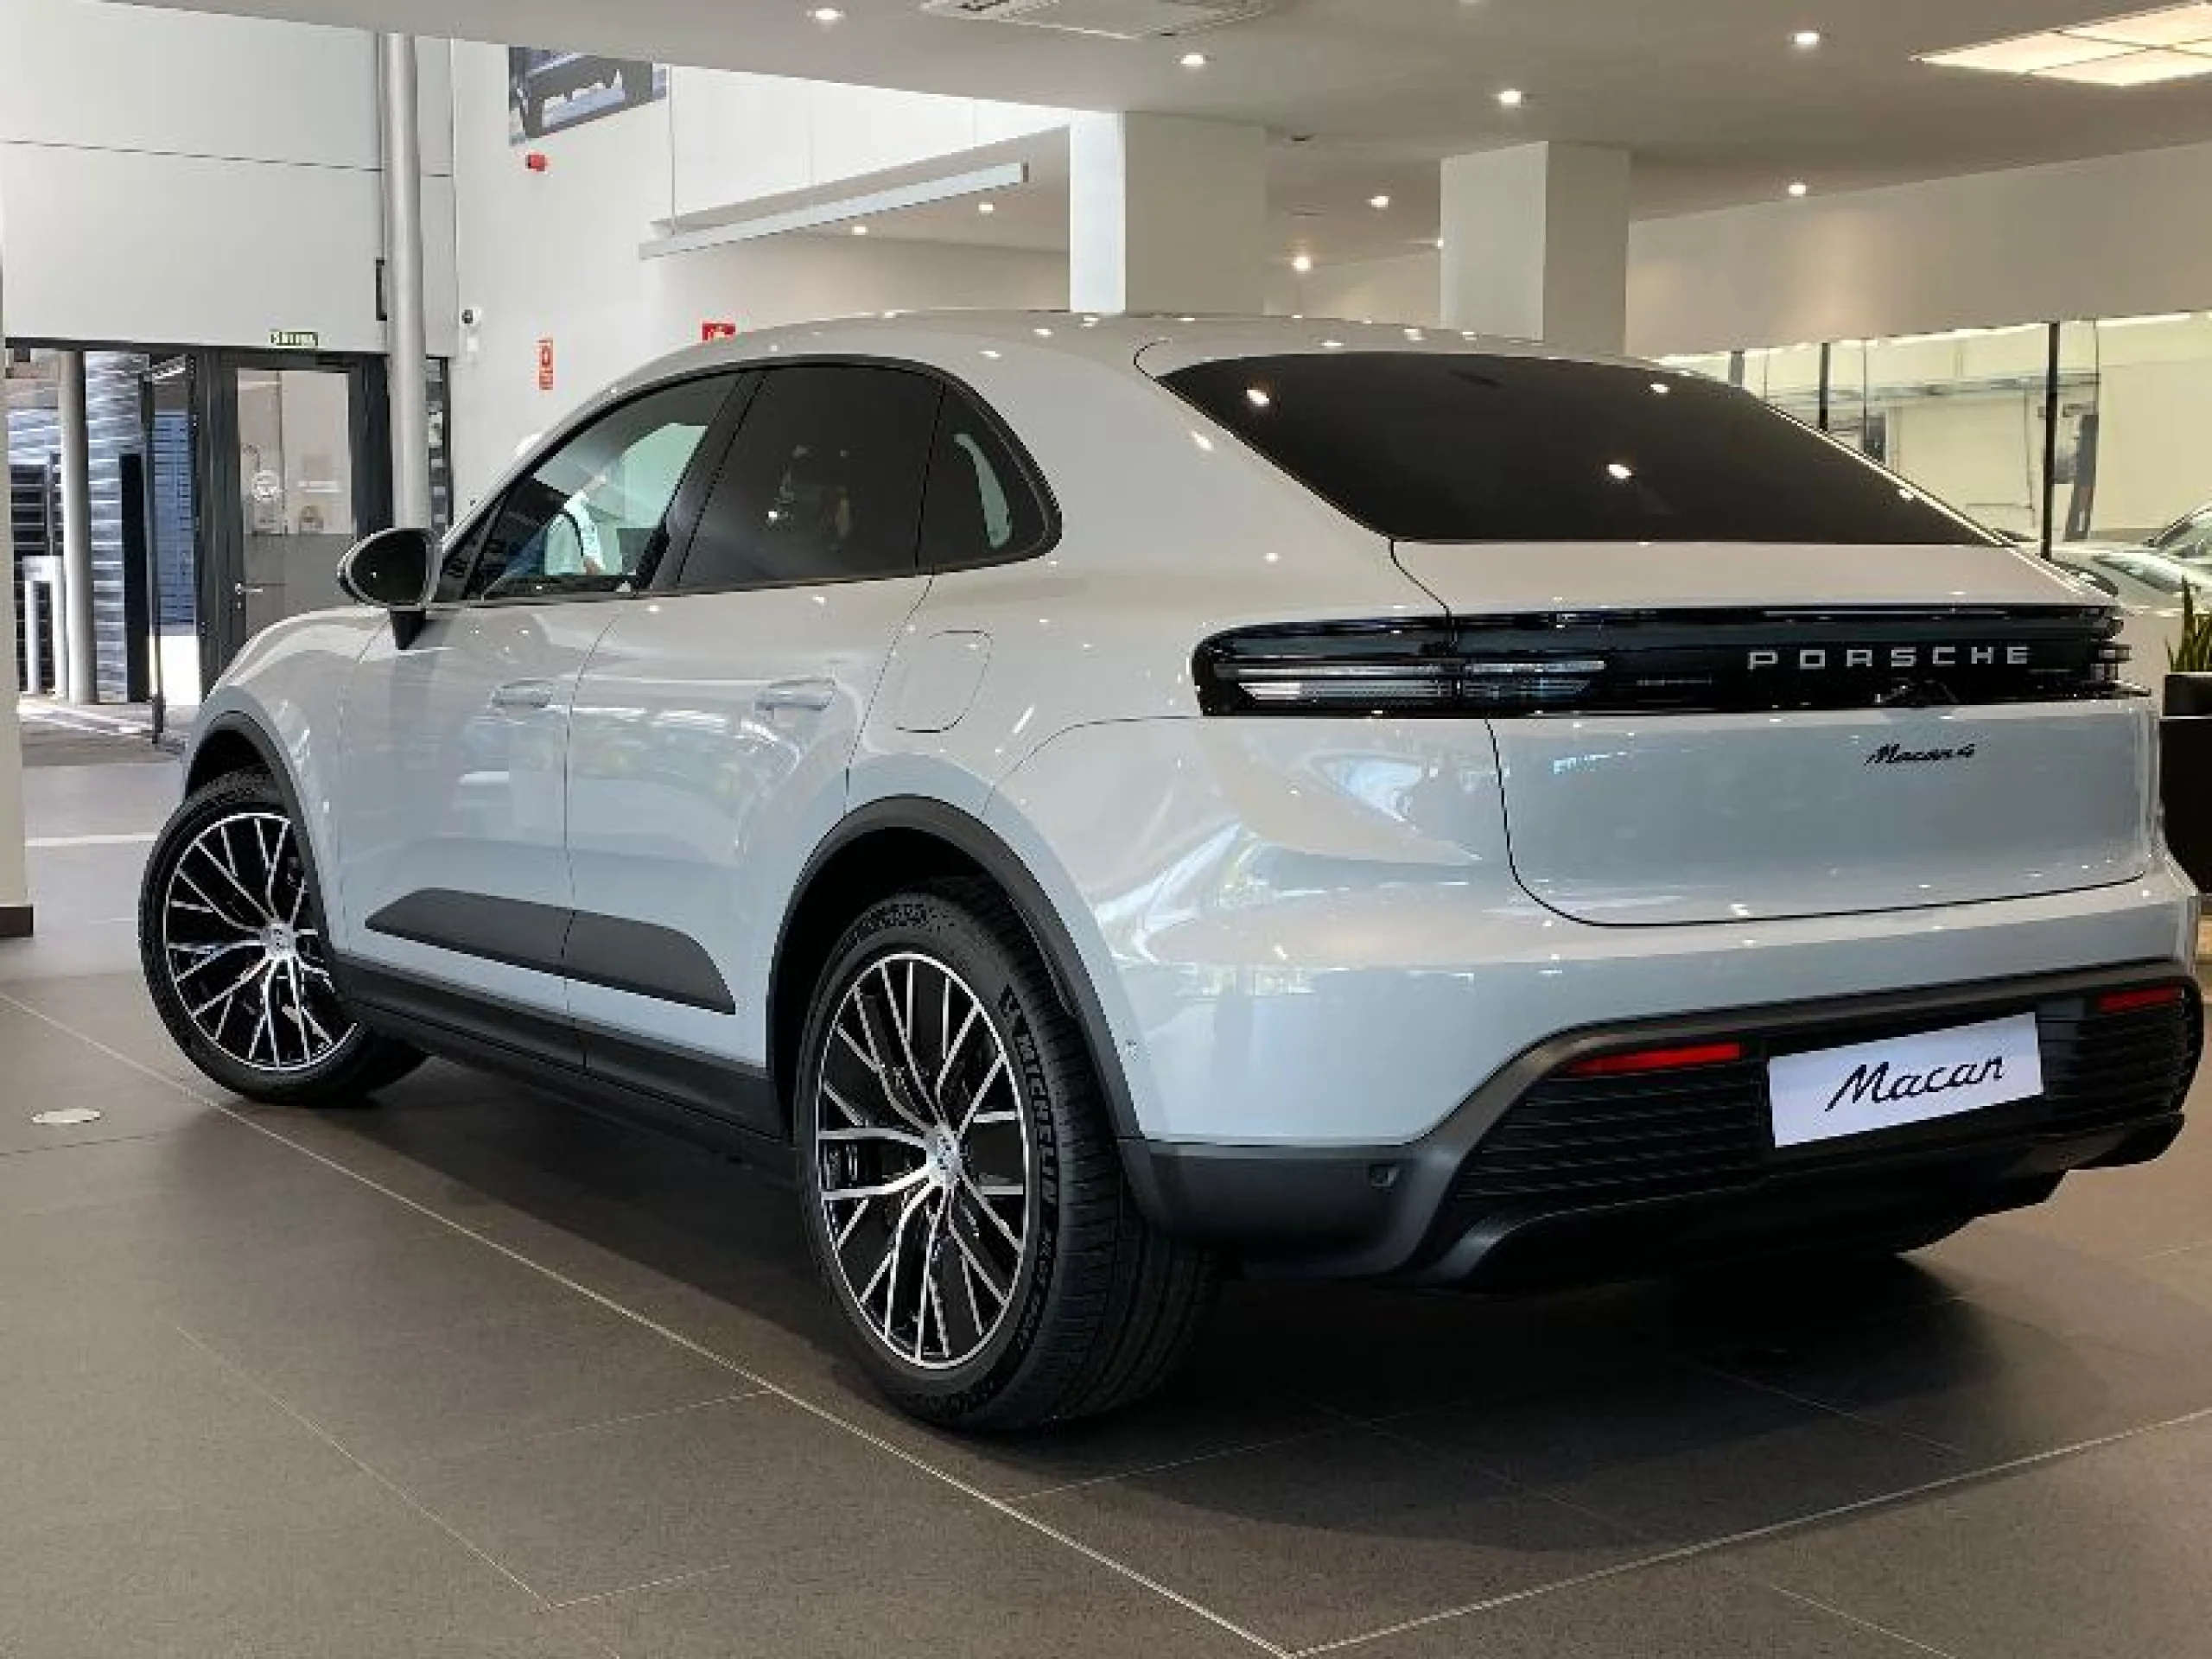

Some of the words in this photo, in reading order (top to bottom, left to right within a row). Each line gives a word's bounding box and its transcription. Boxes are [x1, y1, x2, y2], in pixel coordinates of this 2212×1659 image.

[1747, 646, 2029, 670] PORSCHE
[1864, 739, 1953, 766] Macan
[1824, 1056, 2003, 1113] Macan
[1014, 1033, 1059, 1205] MICHELIN
